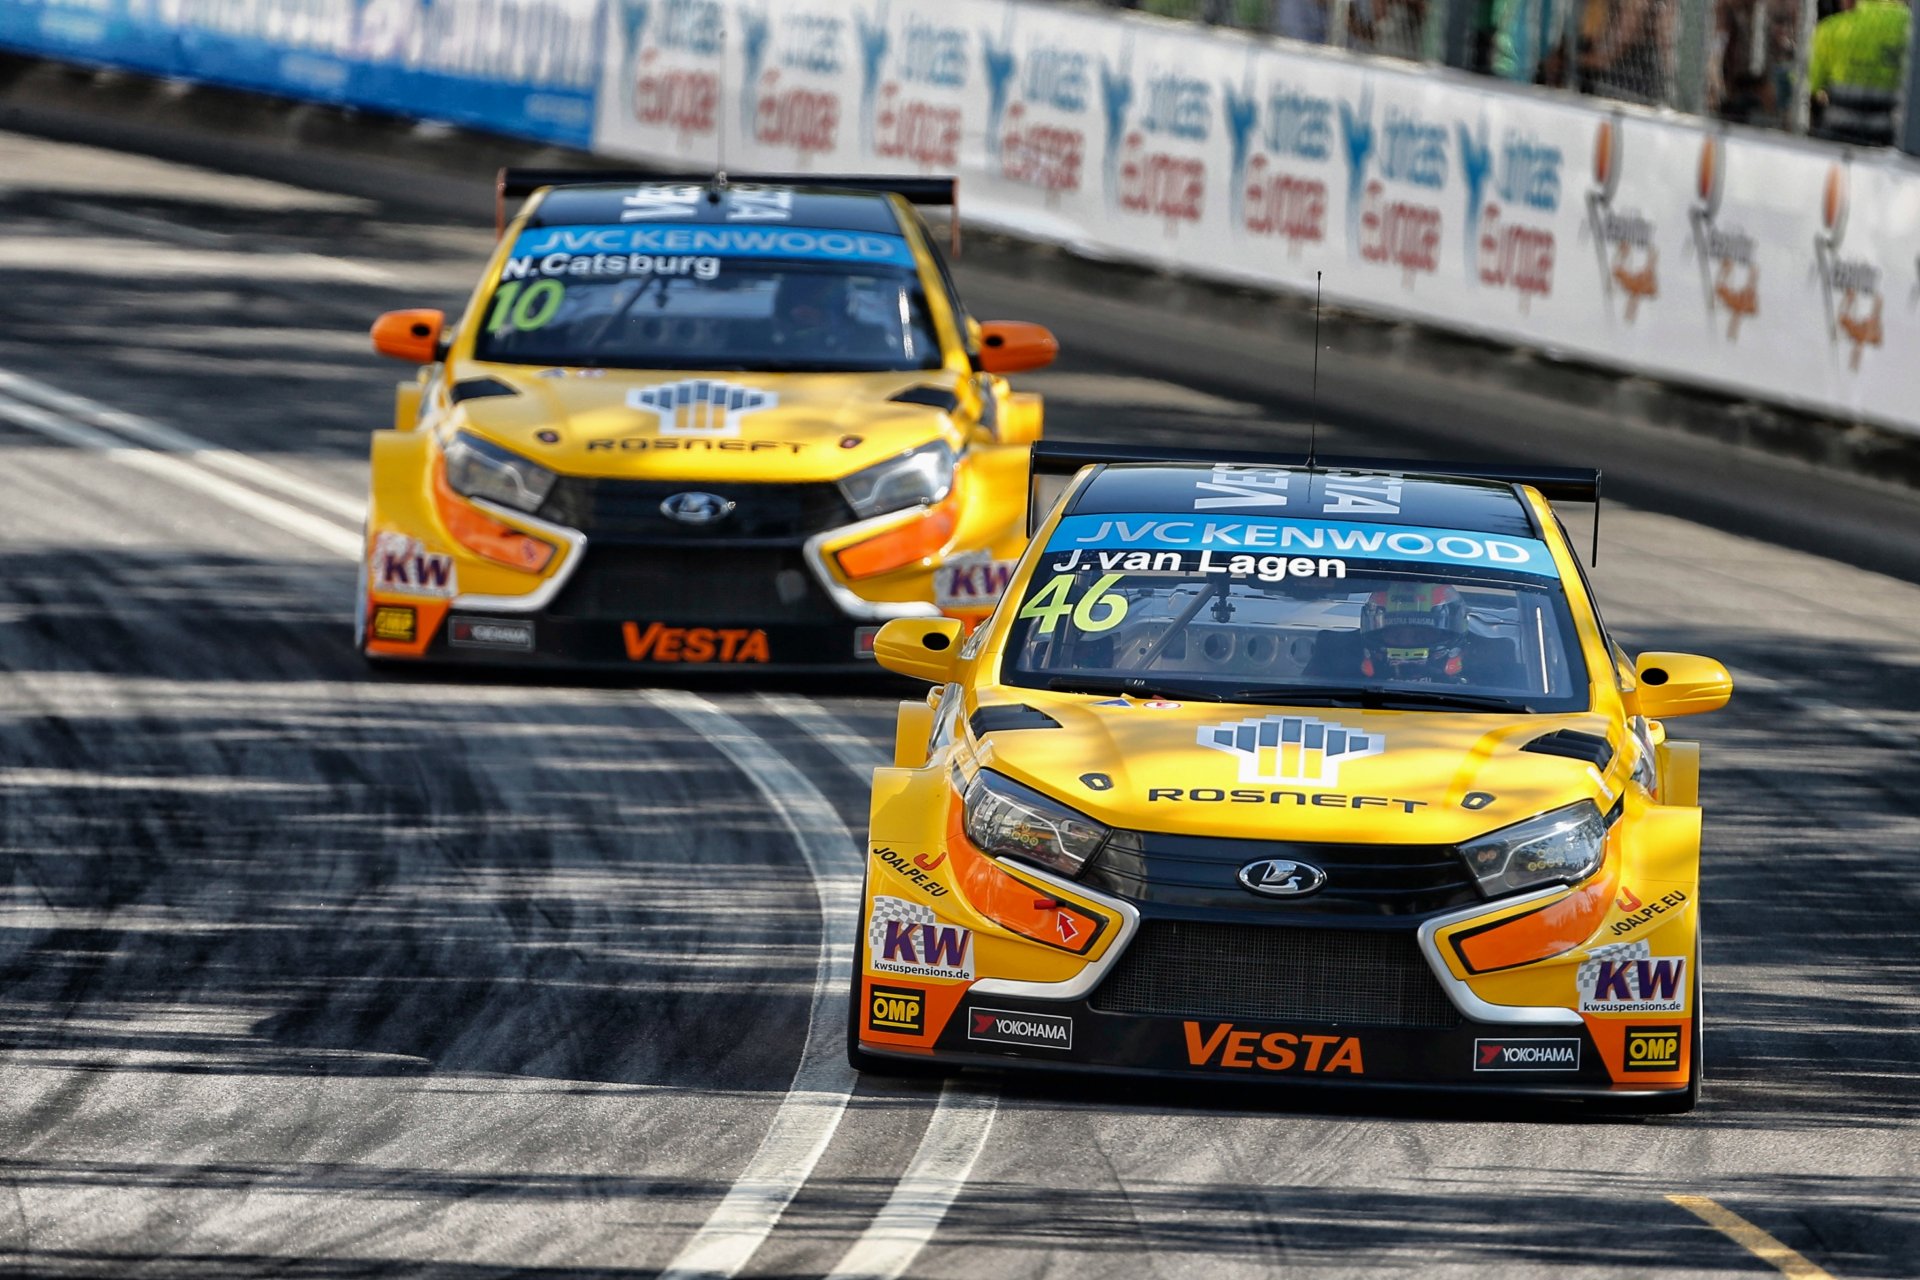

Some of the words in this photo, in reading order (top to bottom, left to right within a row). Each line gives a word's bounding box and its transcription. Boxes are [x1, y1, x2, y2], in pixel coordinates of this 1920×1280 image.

[532, 231, 626, 252] JVC
[632, 231, 894, 257] KENWOOD
[503, 253, 720, 280] N.Catsburg
[487, 279, 565, 332] 10
[586, 437, 808, 455] ROSNEFT
[1076, 521, 1192, 543] JVC
[1201, 523, 1531, 564] KENWOOD
[384, 553, 454, 587] KW
[1053, 549, 1181, 573] J.van
[1199, 550, 1346, 582] Lagen
[1019, 574, 1129, 633] 46
[621, 621, 769, 662] VESTA
[1148, 788, 1428, 814] ROSNEFT
[872, 847, 949, 898] JOALPE.EU
[1610, 890, 1687, 936] JOALPE.EU
[883, 921, 972, 969] KW
[874, 960, 970, 980] kwsuspensions.de
[1593, 959, 1685, 1001] KW
[873, 998, 920, 1022] OMP
[1583, 1001, 1682, 1013] kwsuspensions.de
[995, 1018, 1067, 1041] YOKOHAMA
[1183, 1021, 1364, 1073] VESTA
[1502, 1047, 1575, 1062] YOKOHAMA
[1628, 1038, 1678, 1060] OMP
